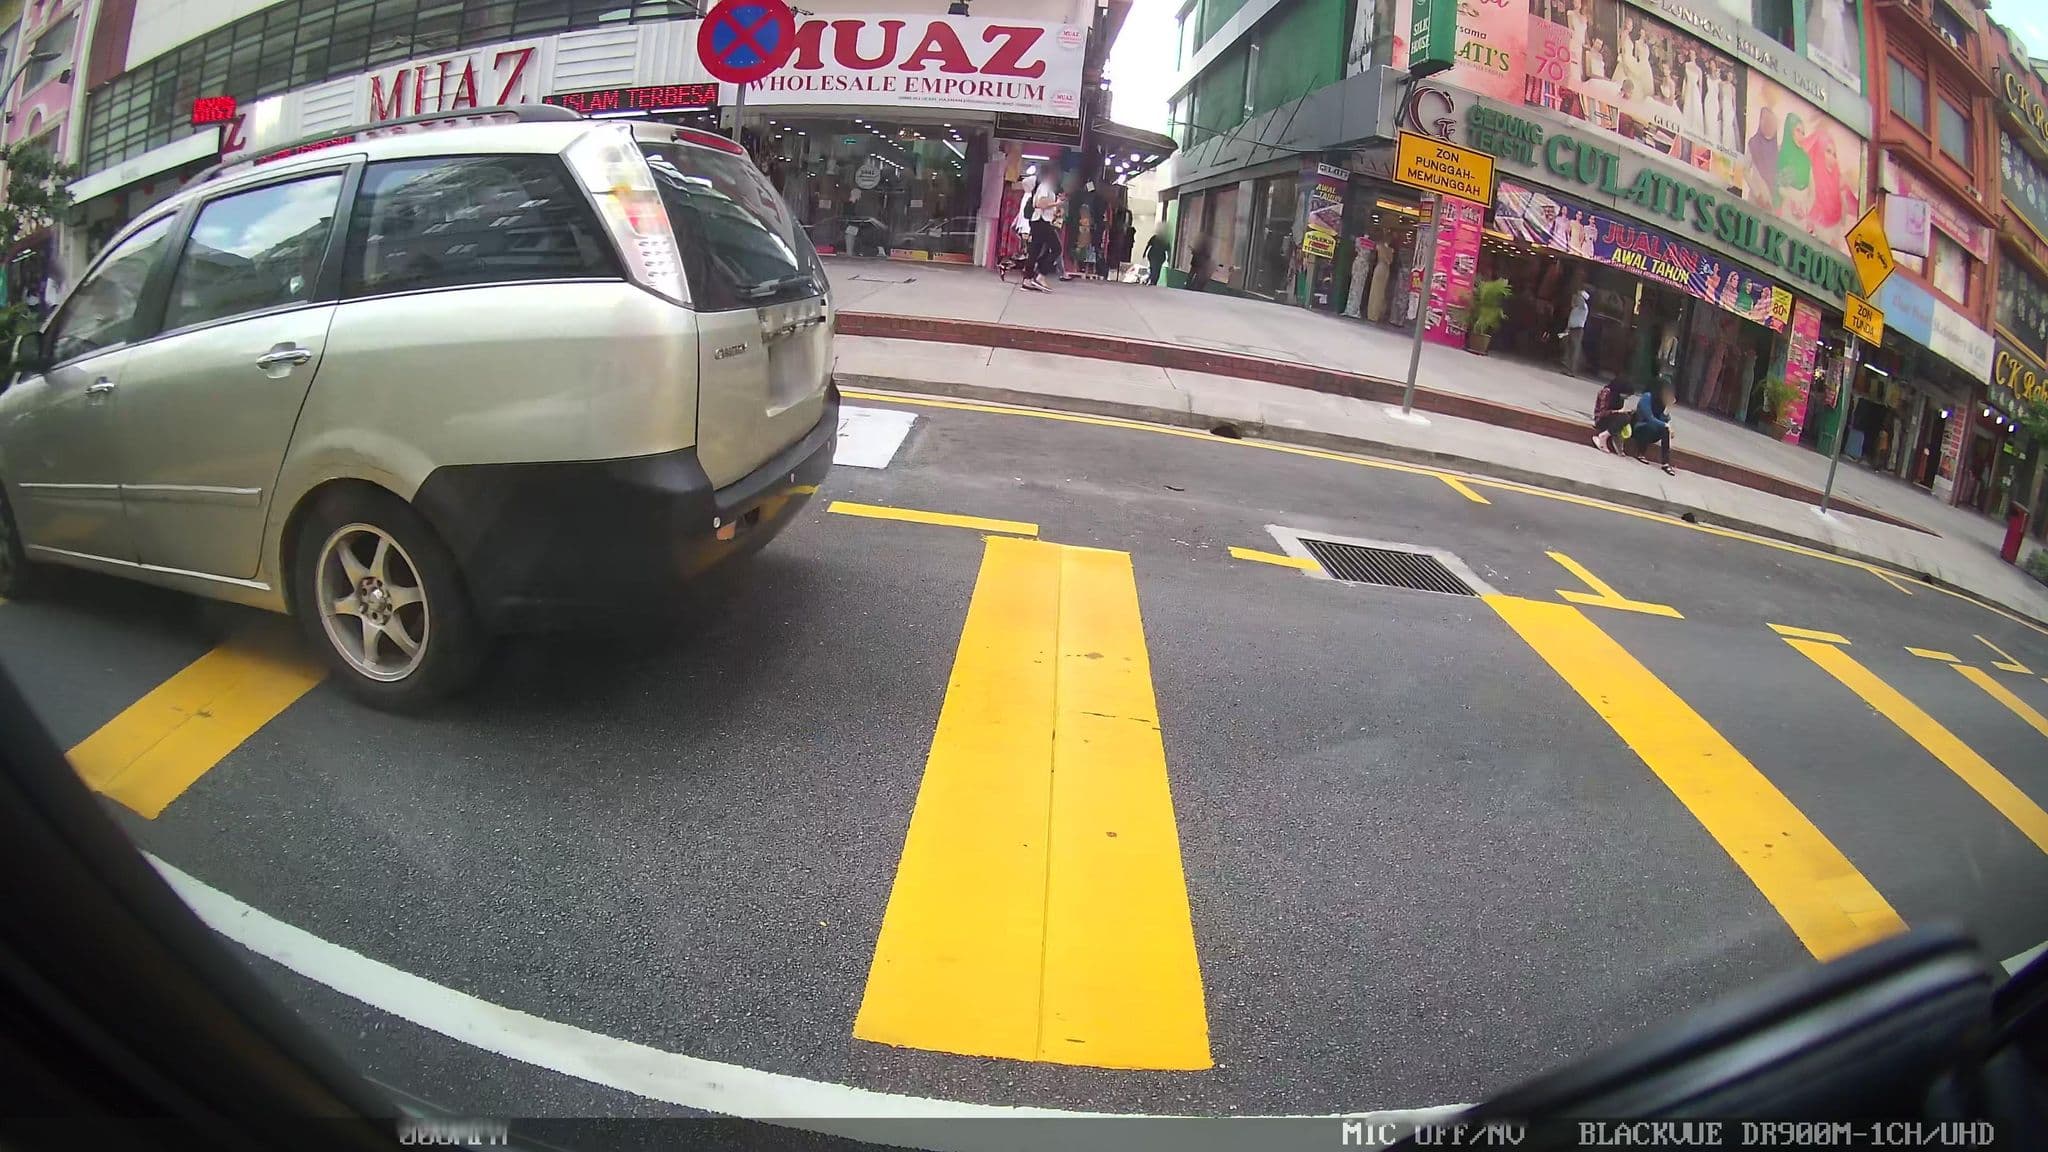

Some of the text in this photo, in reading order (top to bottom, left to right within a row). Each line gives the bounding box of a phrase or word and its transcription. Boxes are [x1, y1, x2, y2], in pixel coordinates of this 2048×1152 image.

[1456, 25, 1487, 40] sama
[1456, 41, 1510, 71] ATI'S
[750, 74, 897, 92] WHOLESALE
[904, 76, 1045, 102] EMPORIUM
[1470, 104, 1544, 145] GEDUNG
[1436, 148, 1460, 163] ZON
[1470, 128, 1538, 168] TEKSTIL
[1407, 168, 1481, 196] MEMUNGGAH
[1415, 156, 1476, 180] PUNGGAH-
[1547, 134, 1716, 233] GULATI'S
[1715, 204, 1784, 267] SILK
[1602, 221, 1700, 274] JUALAN
[1611, 247, 1648, 271] AWAL
[1648, 259, 1690, 285] TAHUN
[1852, 315, 1874, 337] TUNDA
[1858, 304, 1873, 321] ZON
